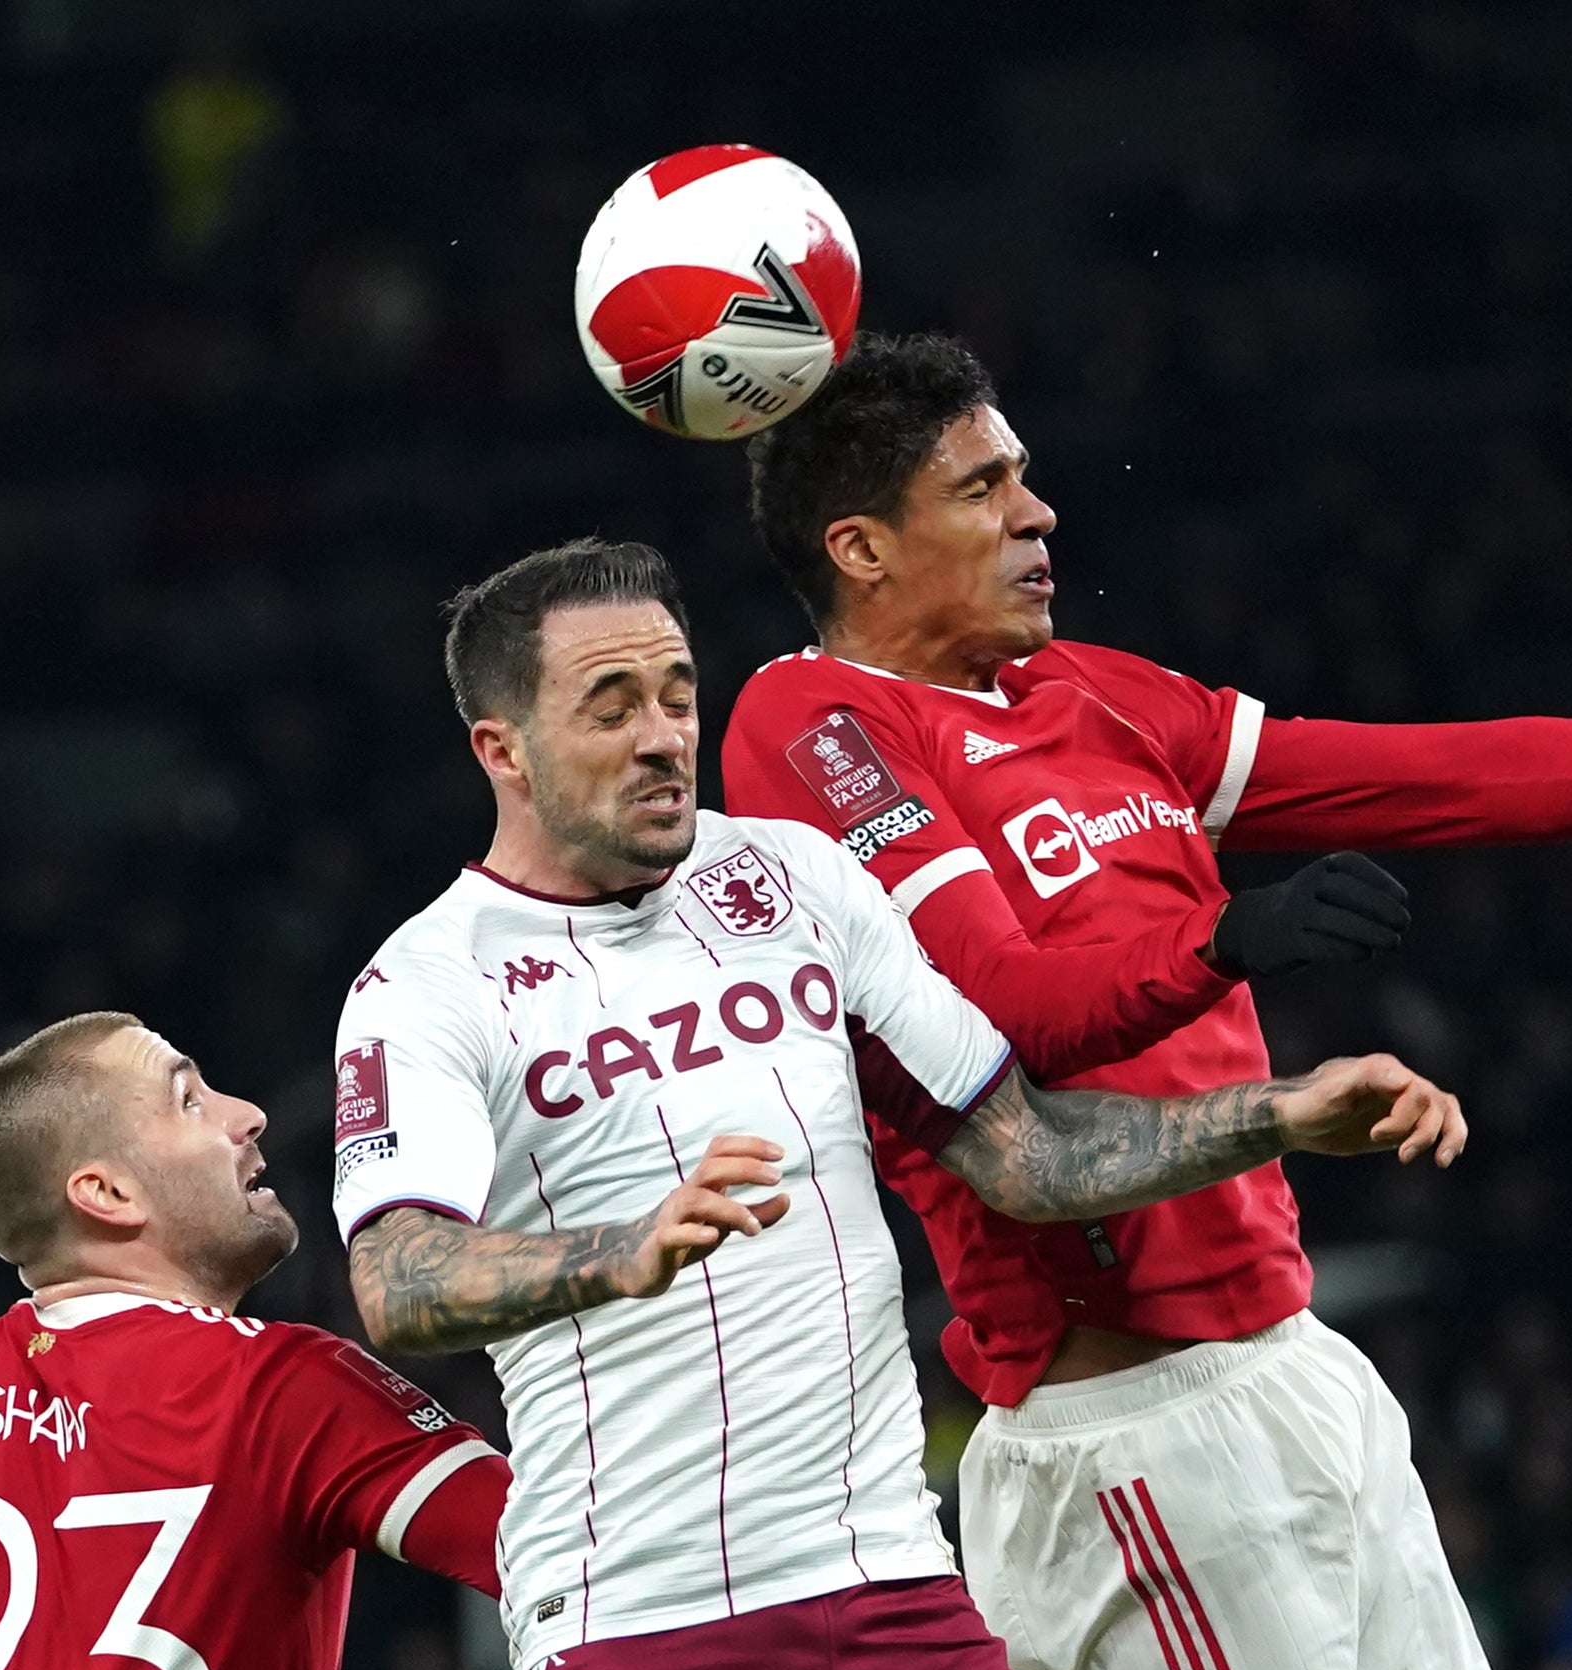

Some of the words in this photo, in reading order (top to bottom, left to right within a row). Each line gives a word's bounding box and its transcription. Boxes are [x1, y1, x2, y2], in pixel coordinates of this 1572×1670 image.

[702, 354, 788, 415] mitre
[965, 742, 1020, 765] adidas
[823, 763, 876, 798] Emirates
[831, 791, 855, 809] FA
[851, 772, 882, 796] CUP
[840, 827, 869, 849] No
[865, 801, 919, 834] room
[854, 838, 877, 862] or
[874, 808, 936, 847] racism
[699, 853, 755, 892] AVFC
[524, 963, 838, 1119] CAZOO
[337, 1096, 376, 1119] mirates
[342, 1105, 377, 1123] CUP
[407, 1406, 438, 1429] No
